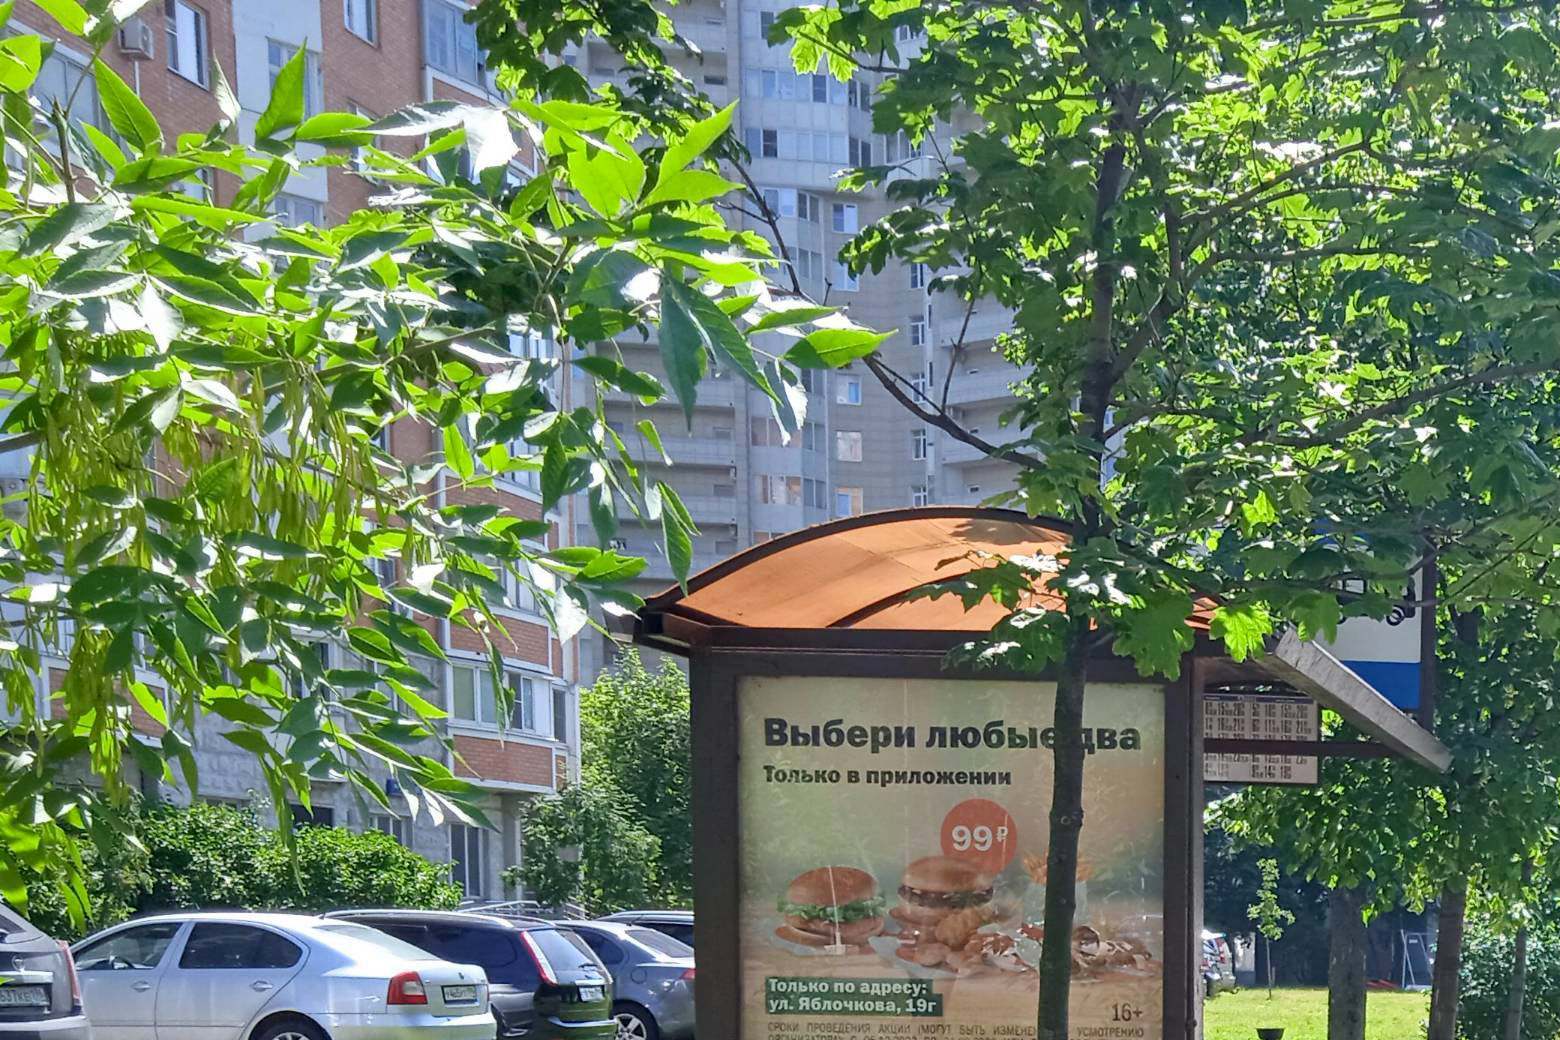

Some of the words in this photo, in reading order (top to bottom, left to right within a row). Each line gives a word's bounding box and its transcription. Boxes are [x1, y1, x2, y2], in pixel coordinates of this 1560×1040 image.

[764, 717, 916, 754] Выбери
[925, 719, 1055, 749] любые
[1080, 727, 1141, 755] два
[763, 765, 841, 784] Только
[847, 770, 860, 784] в
[866, 770, 1012, 787] приложении
[769, 979, 829, 993] Только
[833, 981, 856, 993] по
[860, 982, 927, 996] адресу:
[769, 1000, 794, 1013] ул.
[798, 997, 901, 1014] Яблочкова,
[905, 999, 937, 1013] 19г
[1112, 1003, 1143, 1021] 16+
[768, 1022, 799, 1032] СРОКИ
[806, 1023, 871, 1033] ПРОВЕДЕНИЯ
[879, 1024, 911, 1034] АКЦИИ
[960, 1025, 985, 1035] БЫТЬ
[993, 1025, 1037, 1037] ИЗМЕНЕ
[1077, 1027, 1144, 1038] УСМОТРЕНИЮ
